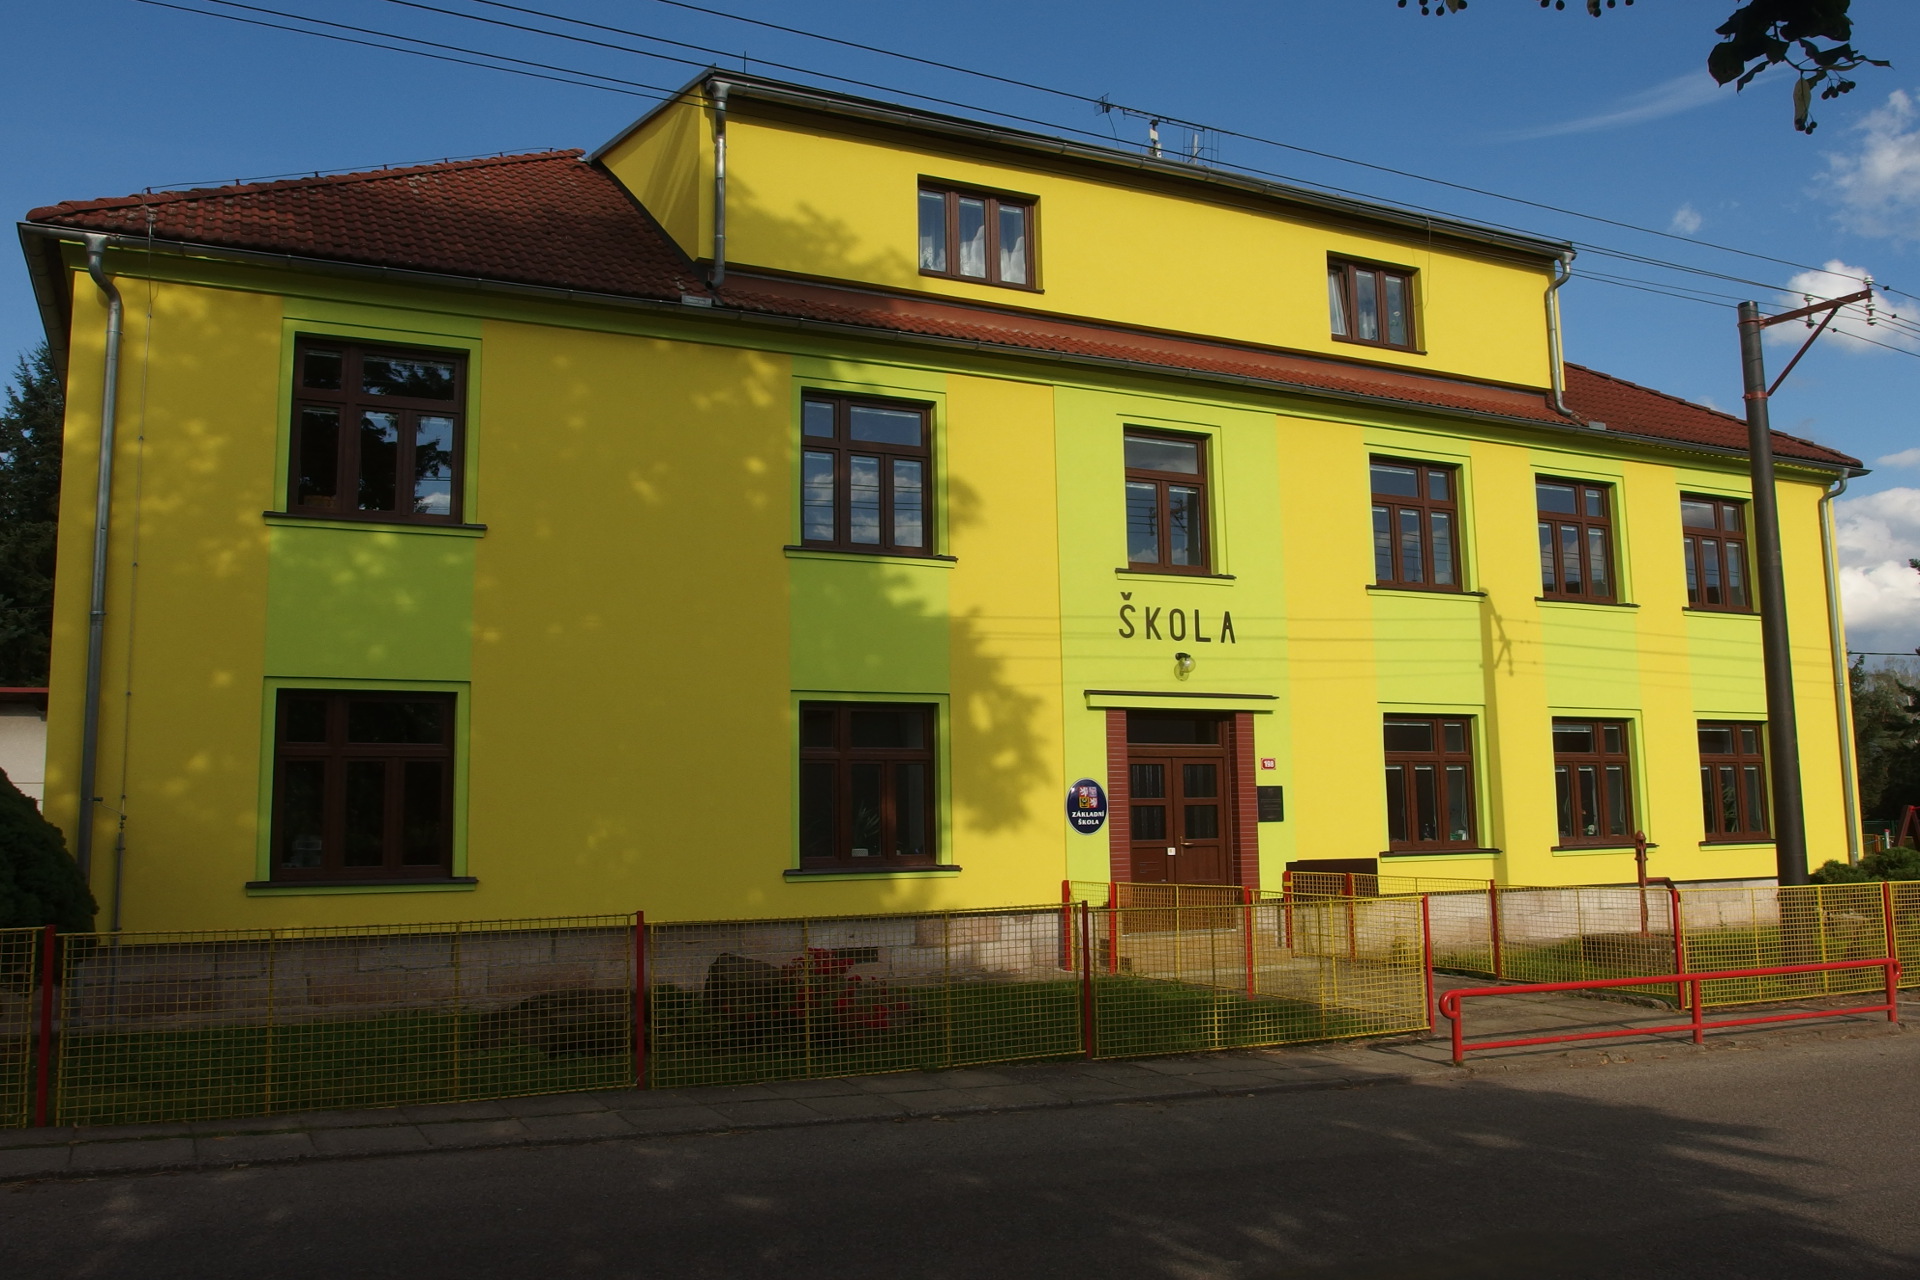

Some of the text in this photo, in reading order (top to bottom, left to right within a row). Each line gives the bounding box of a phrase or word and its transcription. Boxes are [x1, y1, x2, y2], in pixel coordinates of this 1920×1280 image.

[1118, 591, 1236, 644] ŠKOLA
[1071, 810, 1104, 818] ZÁKLADNÍ
[1077, 818, 1099, 826] ŠKOLA
